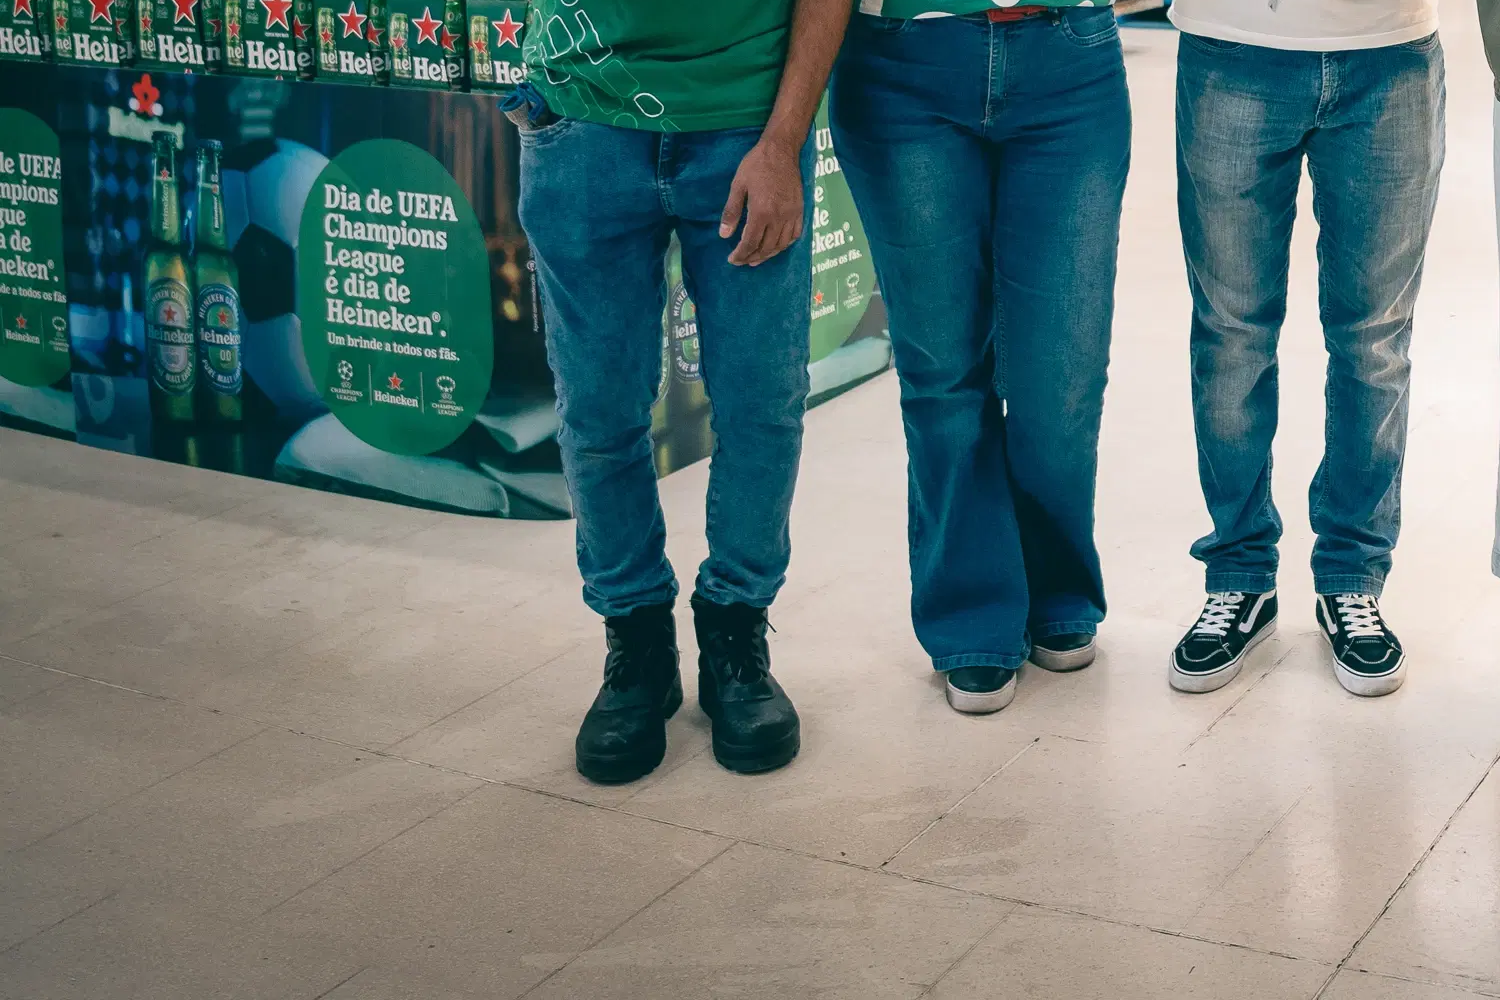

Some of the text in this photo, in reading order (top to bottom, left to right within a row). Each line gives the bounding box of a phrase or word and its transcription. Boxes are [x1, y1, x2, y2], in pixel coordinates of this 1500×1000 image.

[19, 152, 62, 180] UEFA
[324, 184, 459, 222] Dia de UEFA
[9, 229, 32, 252] de
[324, 213, 448, 251] Champions
[324, 241, 405, 277] League
[817, 256, 838, 272] todos
[838, 254, 848, 265] os
[18, 285, 42, 300] todos
[42, 291, 53, 302] os
[325, 268, 411, 304] é dia de
[5, 328, 41, 345] Heineken
[148, 326, 194, 344] Heineken
[327, 331, 460, 362] Um brinde a todos os fãs.
[373, 390, 419, 408] Heineken
